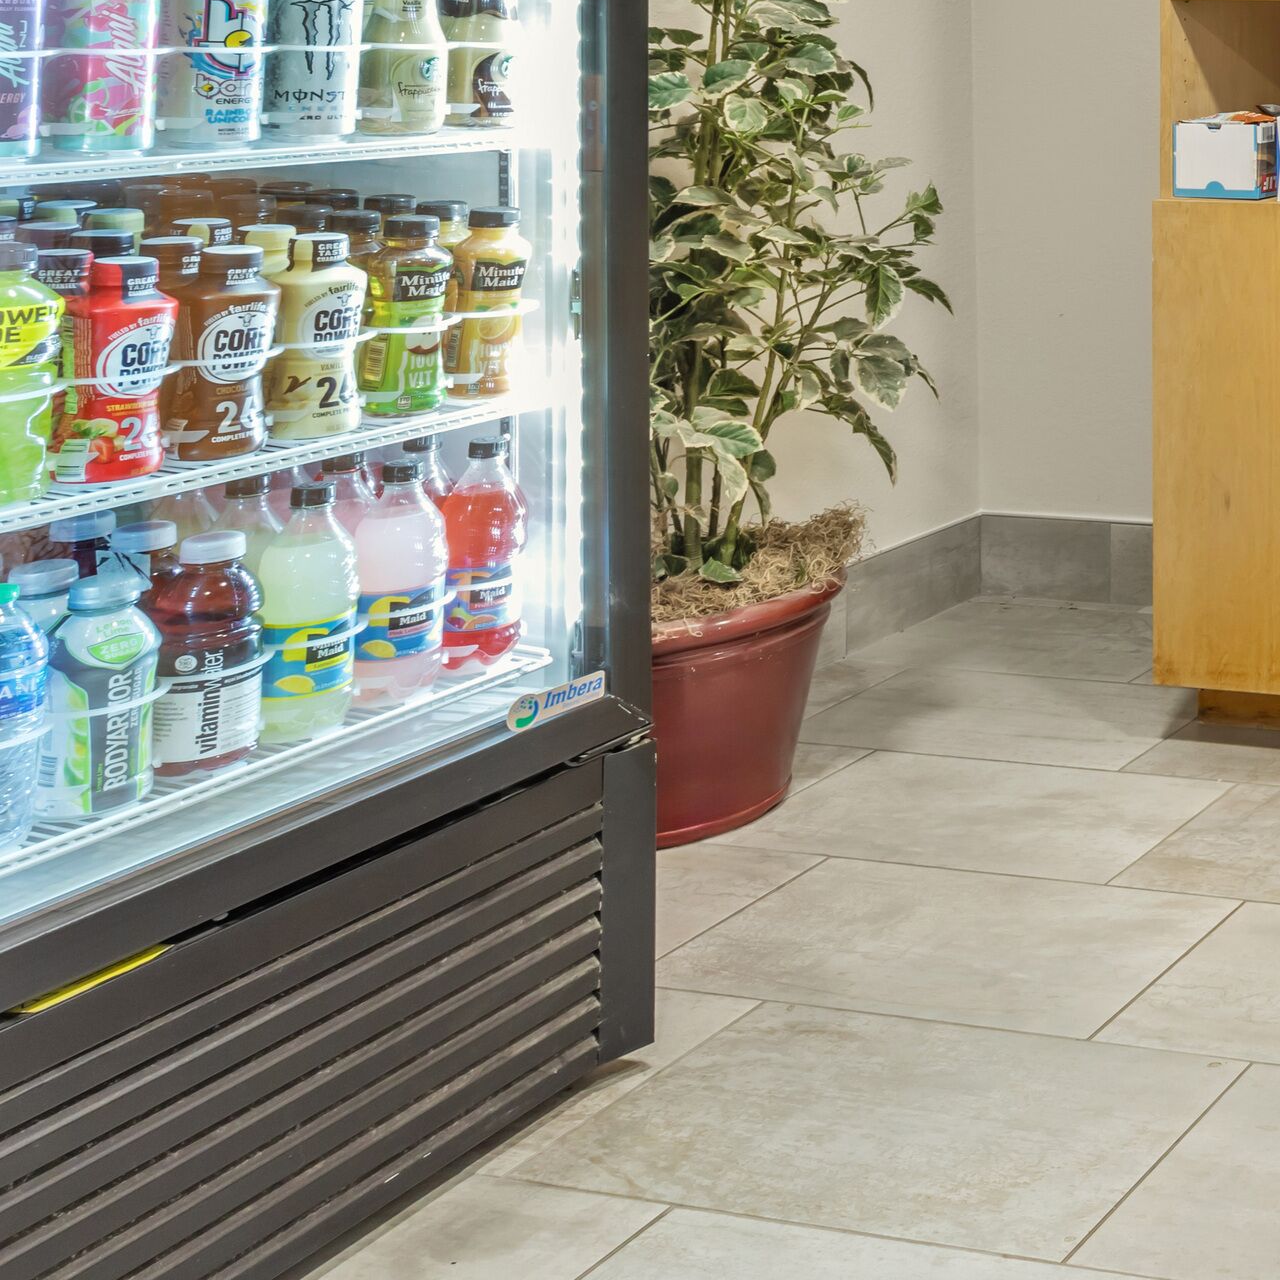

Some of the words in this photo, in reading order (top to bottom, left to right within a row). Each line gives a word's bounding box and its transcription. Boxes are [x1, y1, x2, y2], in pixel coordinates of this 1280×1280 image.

[226, 267, 258, 276] GREAT
[478, 266, 524, 278] Minute
[127, 276, 157, 285] GREAT
[400, 272, 450, 288] Minute
[484, 274, 519, 287] Maid
[407, 283, 446, 298] Maid
[479, 586, 506, 600] Maid
[399, 610, 428, 626] Maid
[316, 641, 345, 658] Maid
[543, 676, 603, 710] Imbera
[103, 671, 132, 792] BODYAROR
